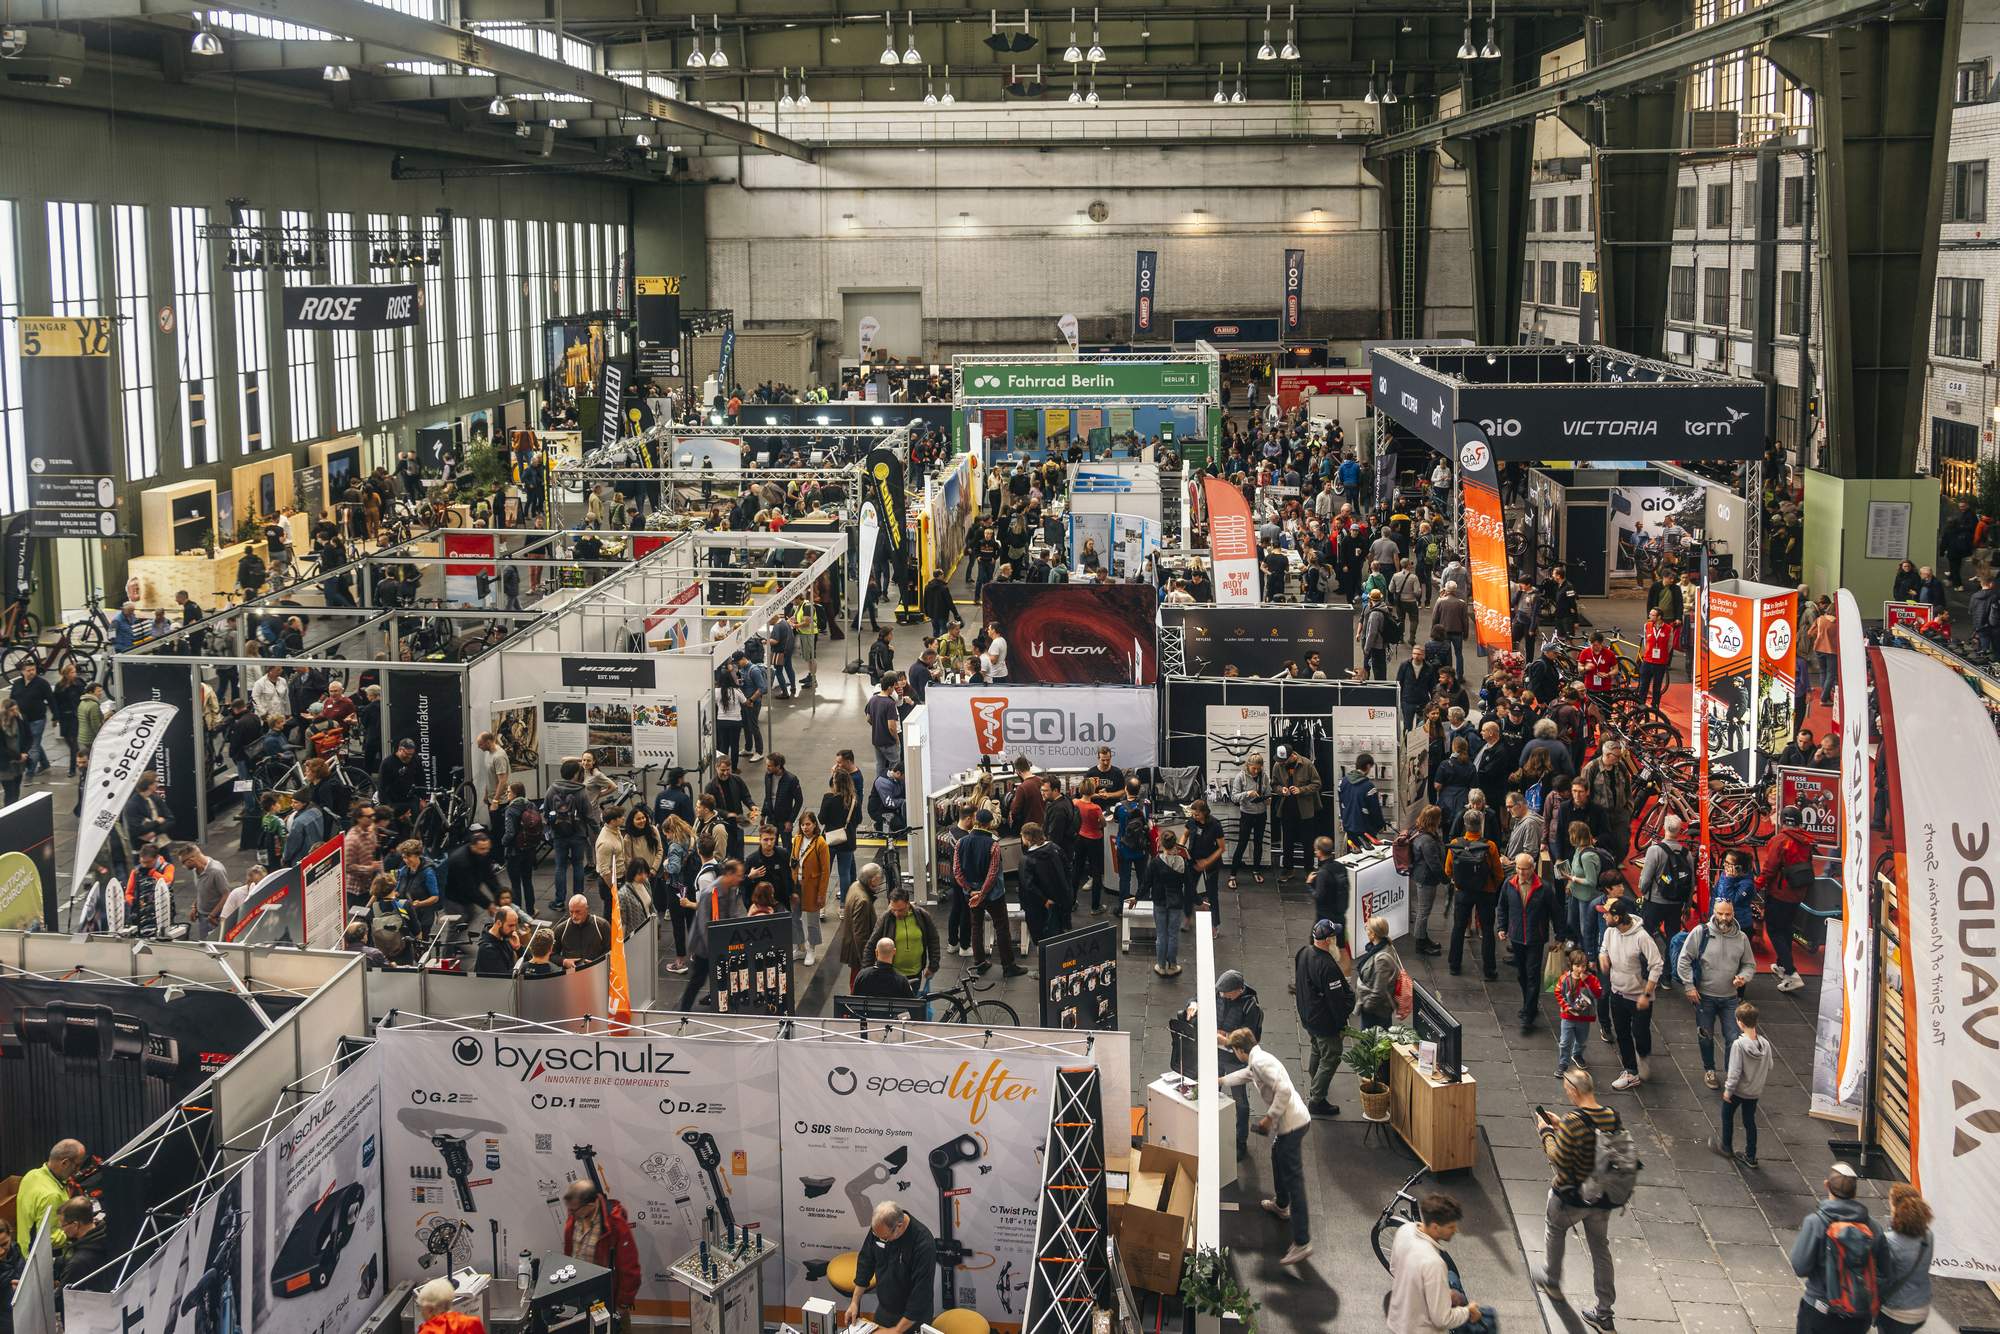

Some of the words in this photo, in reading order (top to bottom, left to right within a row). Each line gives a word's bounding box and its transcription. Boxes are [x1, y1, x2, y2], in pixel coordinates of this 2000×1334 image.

[1140, 270, 1150, 292] 100
[1289, 268, 1298, 290] 100
[638, 284, 646, 294] 5
[299, 297, 362, 320] ROSE
[386, 296, 412, 320] ROSE
[1140, 298, 1149, 326] ABUS
[1289, 298, 1297, 325] ABUS
[24, 323, 67, 331] HANGAR
[74, 318, 110, 338] VE
[24, 332, 41, 355] 5
[718, 334, 733, 382] DAHON
[1008, 375, 1066, 387] Fahrrad
[1072, 375, 1114, 387] Berlin
[1401, 390, 1418, 415] VICTORIA
[1431, 405, 1442, 429] tern
[1479, 419, 1521, 436] QiO
[1563, 421, 1657, 435] VICTORIA
[1685, 421, 1731, 435] tern
[1641, 498, 1675, 511] QiO
[1717, 503, 1730, 521] QiO
[1718, 599, 1732, 607] Berlin
[1709, 625, 1740, 647] RAD
[1769, 630, 1789, 647] RAD
[1049, 646, 1108, 655] CROW
[1004, 709, 1116, 743] SQlab
[114, 714, 158, 780] SPECOM
[1005, 745, 1045, 756] SPORTS
[1796, 782, 1818, 790] DEAL
[1806, 825, 1834, 833] ALLES!
[1372, 887, 1404, 914] SQlab
[731, 927, 773, 941] AXA
[1064, 941, 1100, 960] AXA
[1062, 960, 1077, 968] BIKE
[495, 1037, 691, 1081] byschulz
[544, 1075, 592, 1085] INNOVATIVE
[594, 1076, 613, 1086] BIKE
[615, 1078, 669, 1088] COMPONENTS
[430, 1092, 458, 1103] G.2
[551, 1097, 575, 1108] D.1
[678, 1102, 707, 1113] D.2
[280, 1100, 336, 1161] byschulz
[811, 1124, 831, 1134] SDS
[834, 1125, 852, 1134] Stem
[855, 1126, 884, 1136] Docking
[886, 1127, 913, 1137] System
[999, 1206, 1020, 1215] Twist
[1022, 1208, 1037, 1216] Pro
